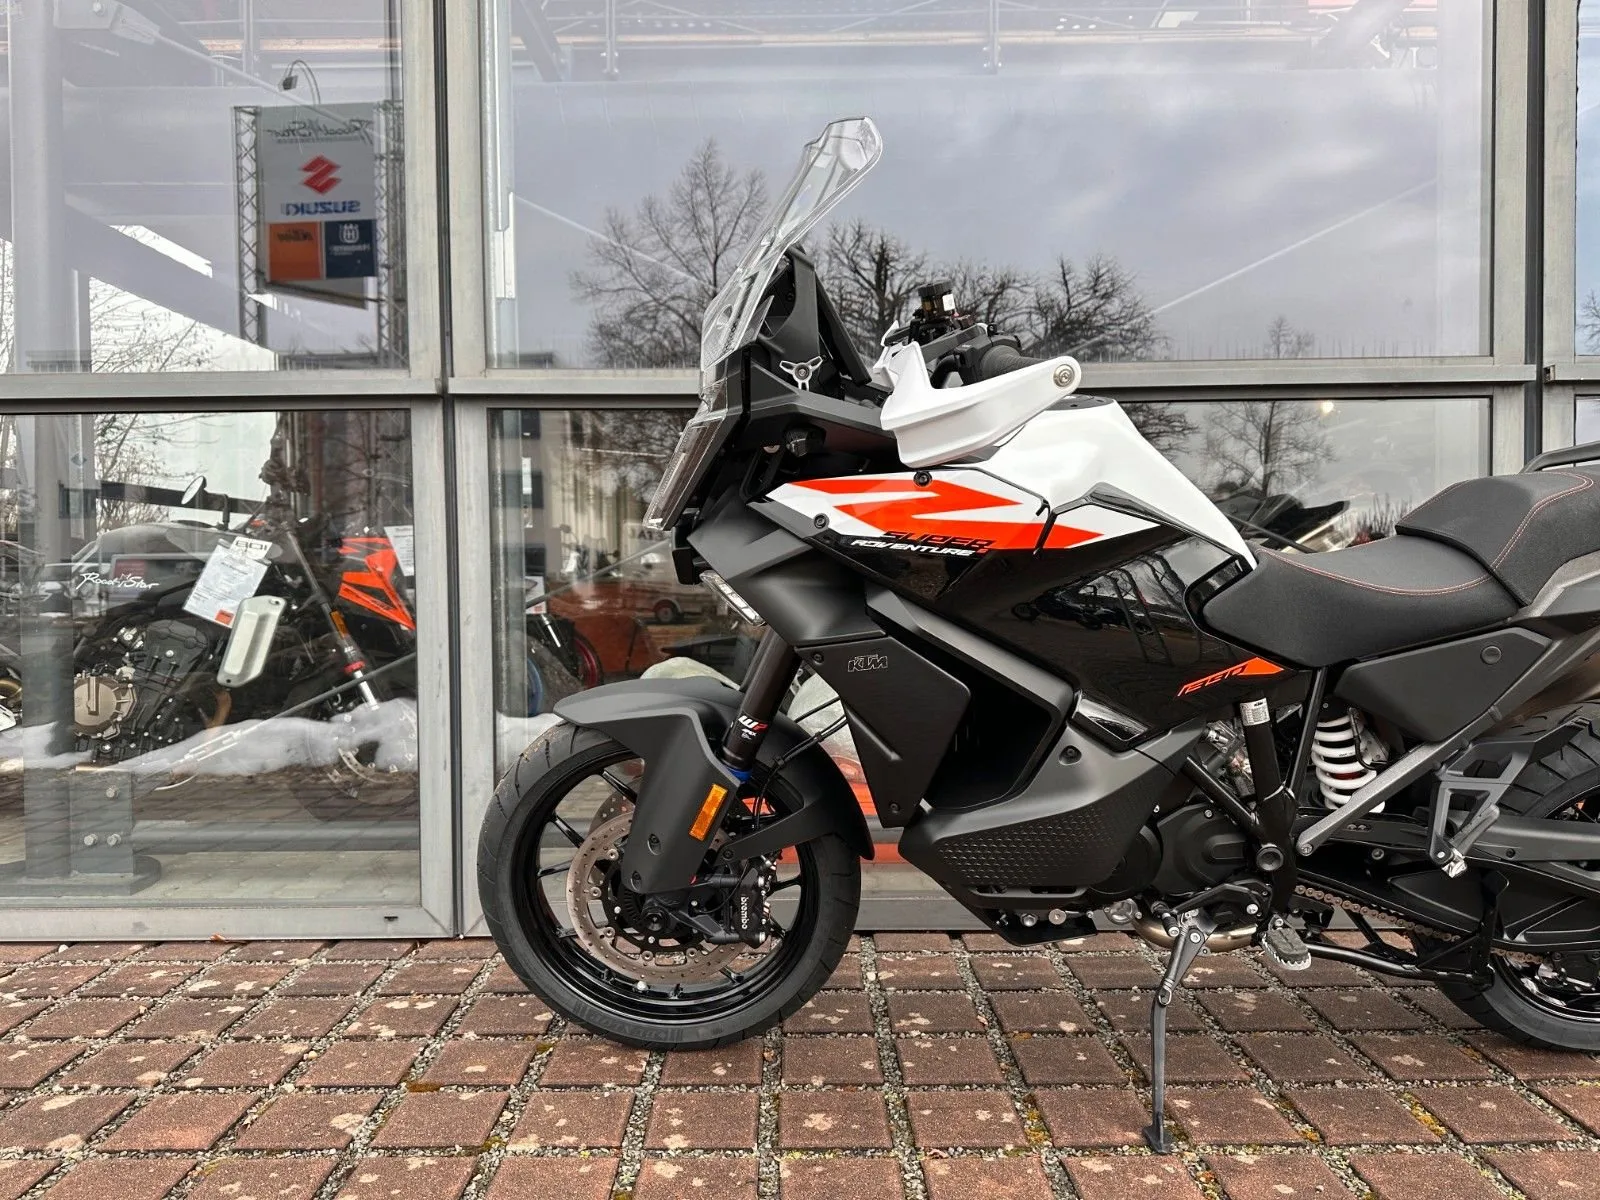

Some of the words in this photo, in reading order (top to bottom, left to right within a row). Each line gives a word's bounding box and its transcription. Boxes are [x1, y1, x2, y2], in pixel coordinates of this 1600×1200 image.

[850, 539, 976, 557] ADVENTURE
[880, 530, 997, 556] SUPER
[847, 654, 888, 673] KTM
[738, 715, 768, 731] WP
[740, 896, 750, 930] brembo
